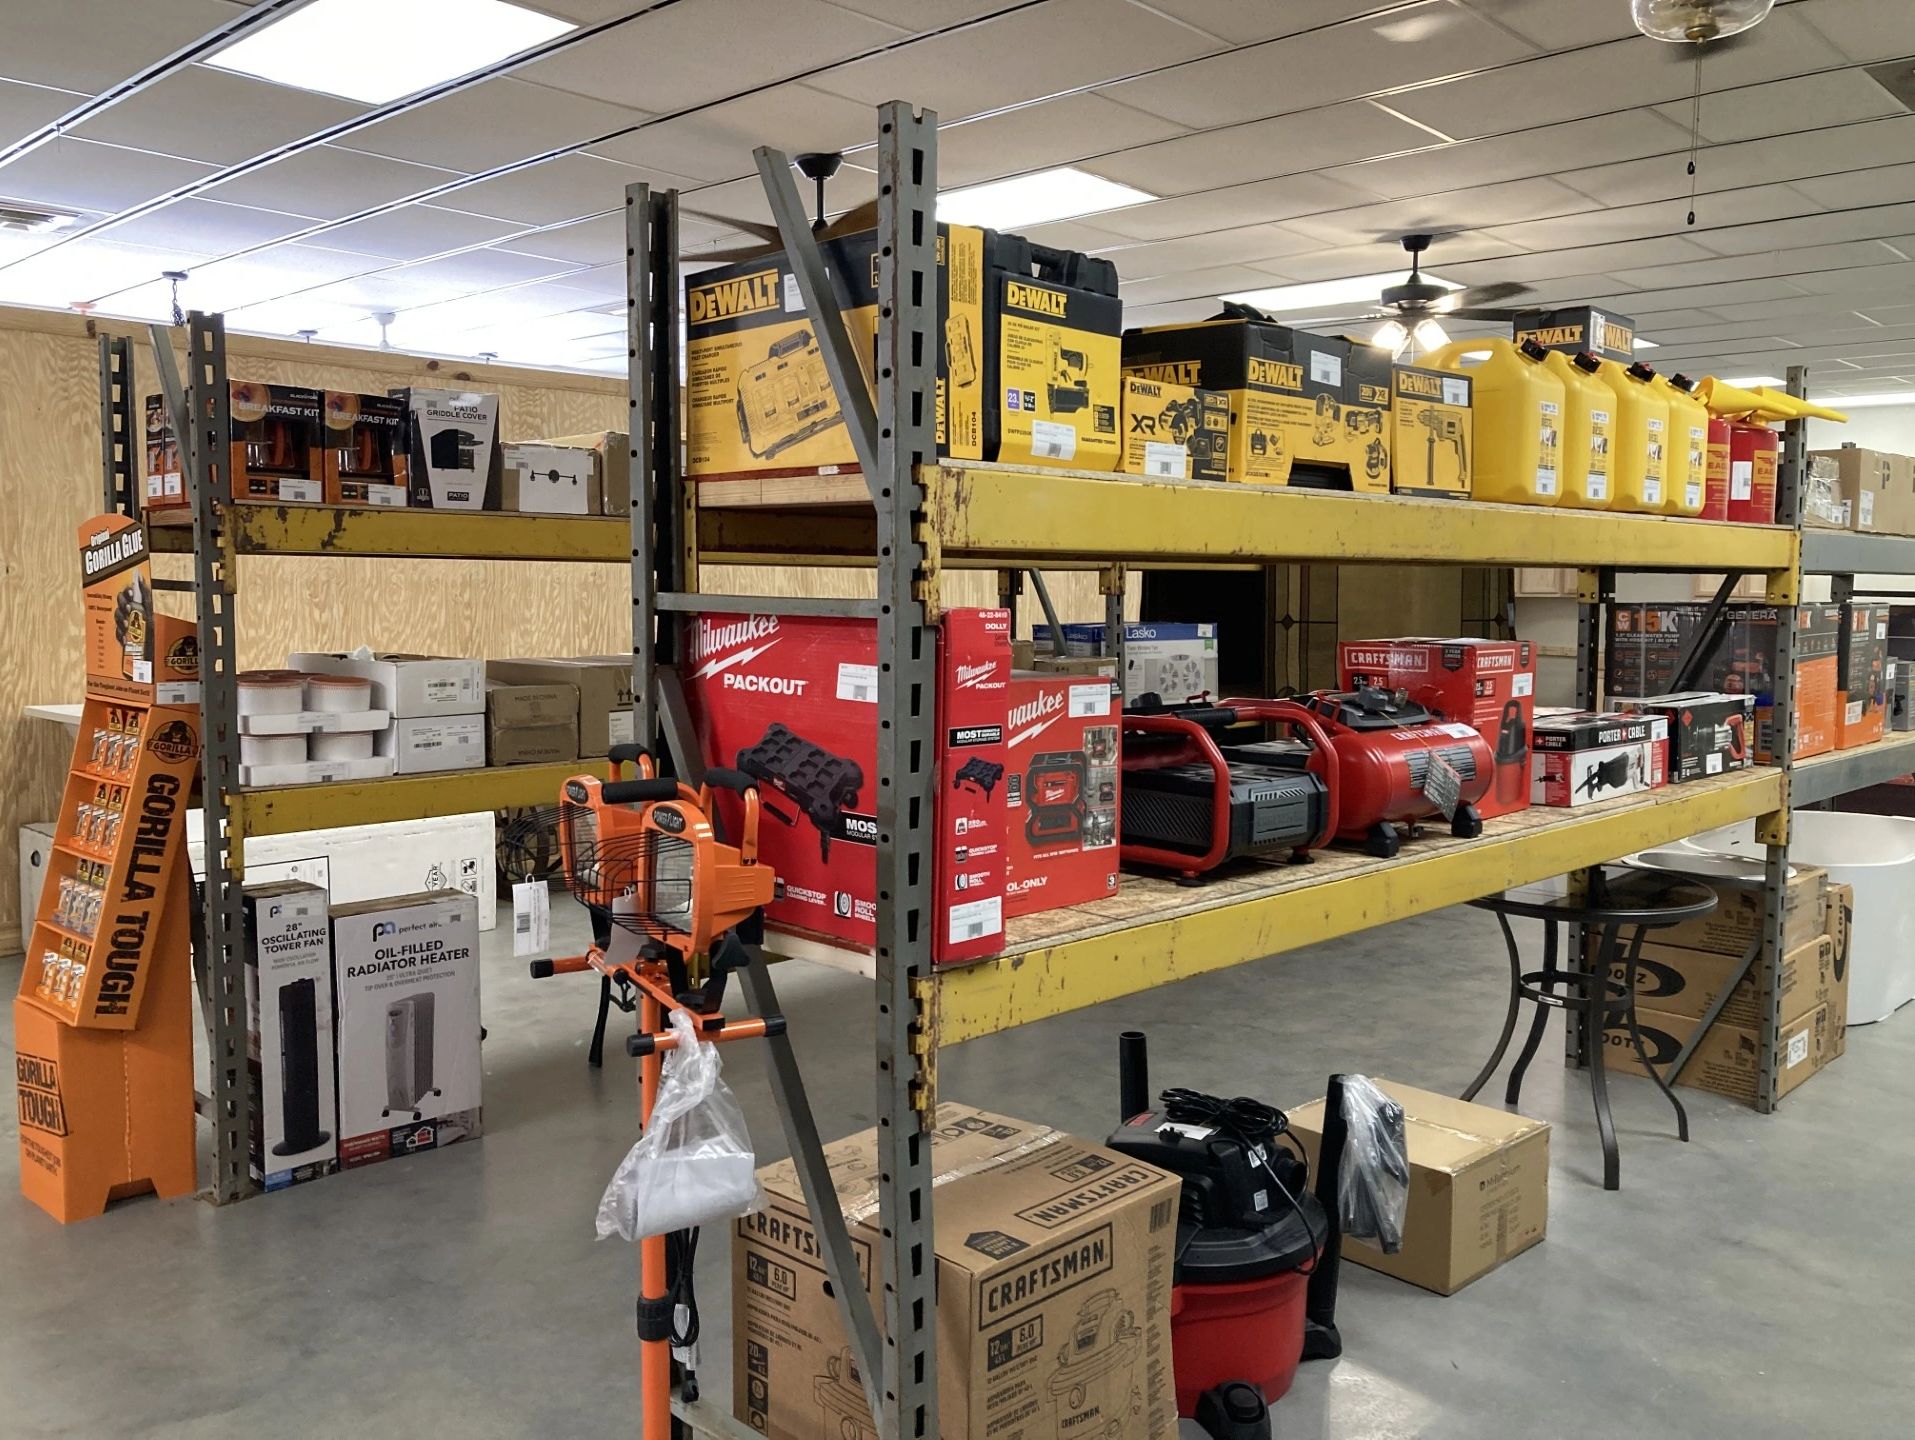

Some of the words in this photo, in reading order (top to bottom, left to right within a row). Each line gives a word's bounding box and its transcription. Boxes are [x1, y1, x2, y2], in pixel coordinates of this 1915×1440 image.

[689, 274, 779, 321] DEWALT
[1008, 284, 1067, 316] DEWALT
[1605, 325, 1633, 352] WALT
[1249, 360, 1303, 387] DEWALT
[1130, 382, 1161, 397] DEWALT
[1400, 374, 1441, 396] DEWALT
[239, 402, 302, 417] BREAKFAST
[303, 408, 319, 418] KIT
[333, 411, 386, 425] BREAKFAST
[387, 417, 399, 426] KIT
[427, 409, 460, 419] GRIDDLE
[462, 411, 487, 421] COVER
[1130, 413, 1156, 435] XR
[85, 541, 122, 575] GORILLA
[121, 528, 144, 560] GLUE
[1633, 611, 1678, 633] 15K
[1727, 611, 1777, 620] GENERA
[689, 614, 780, 665] Milwaukee
[1126, 627, 1157, 640] Lasko
[170, 655, 199, 666] GORILL
[1351, 652, 1422, 667] CRAFTSMAN
[1477, 655, 1512, 669] CRAFTSMAN
[955, 661, 997, 684] Milwaukee
[724, 673, 807, 696] PACKOUT
[976, 682, 1006, 690] PACKOUT
[957, 730, 982, 740] MOST
[1599, 729, 1621, 743] PORTER
[1628, 725, 1646, 738] CABLE
[153, 741, 192, 756] GORILLA
[846, 818, 877, 834] MOS
[120, 774, 181, 902] GORILLA
[787, 885, 827, 899] QUICKSTOP
[1007, 876, 1048, 892] OL-ONLY
[855, 900, 876, 911] SMOO
[856, 906, 874, 916] ROLL
[261, 928, 326, 945] OSCILLATING
[398, 924, 427, 934] perfect
[264, 942, 301, 954] TOWER
[304, 938, 324, 949] FAN
[374, 940, 443, 961] OIL-FILLED
[95, 911, 149, 1015] TOUGH
[347, 957, 417, 978] RADIATOR
[420, 948, 470, 966] HEATER
[16, 1057, 56, 1089] GORILLA
[19, 1088, 61, 1131] TOUGH
[1033, 1170, 1149, 1221] CRAFTSMAN
[747, 1211, 826, 1258] CRAFTS
[774, 1267, 787, 1285] 6.0
[988, 1239, 1105, 1312] CRAFTSMAN
[1020, 1324, 1034, 1342] 6.0
[1062, 1406, 1100, 1428] CRAFTSMAN
